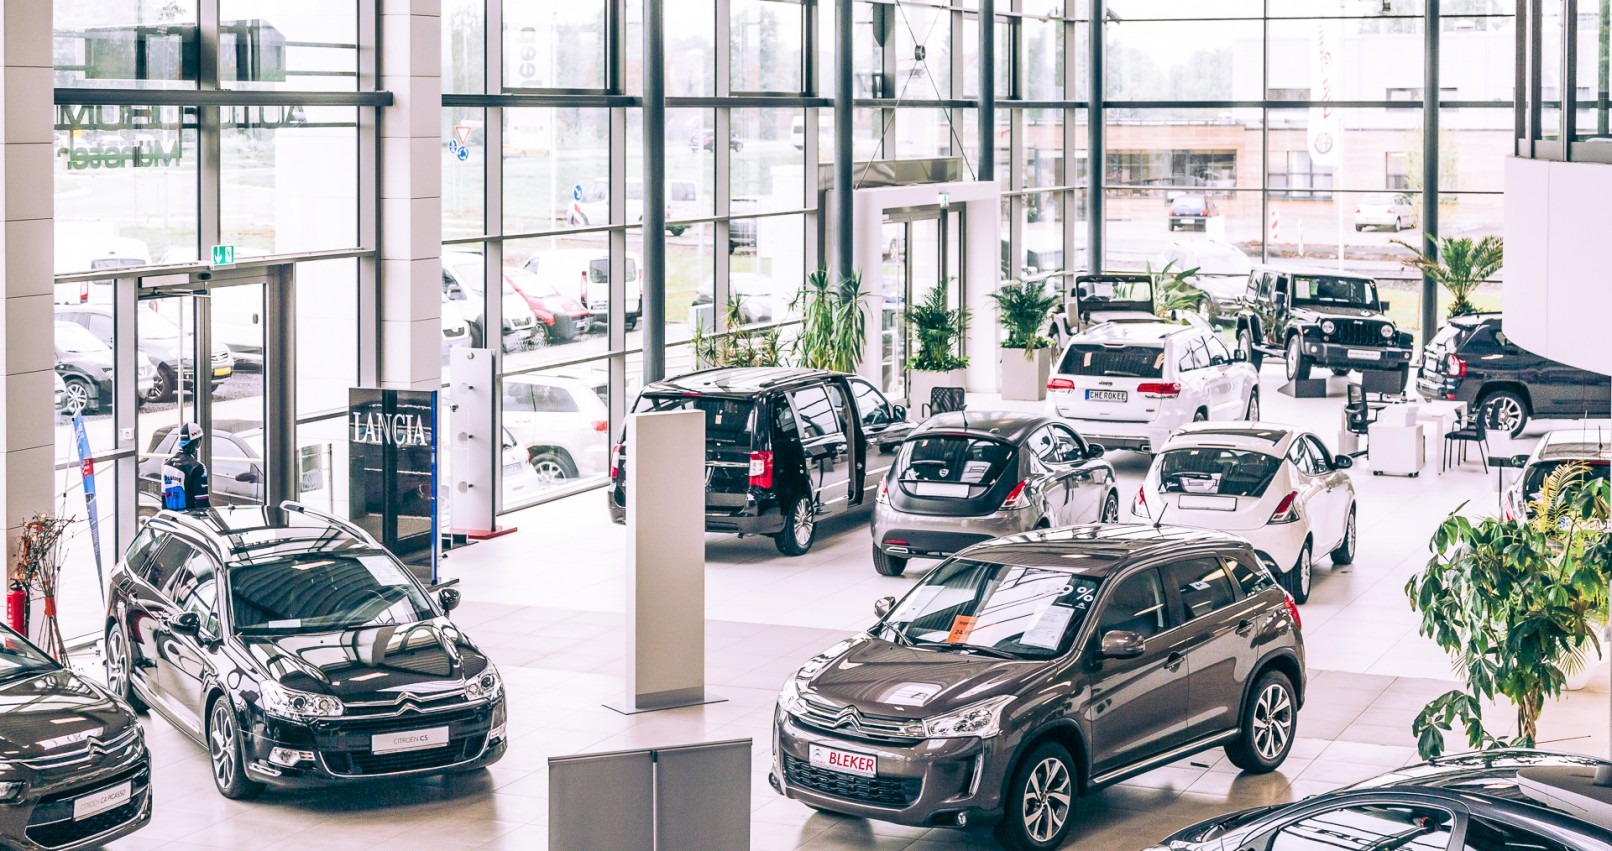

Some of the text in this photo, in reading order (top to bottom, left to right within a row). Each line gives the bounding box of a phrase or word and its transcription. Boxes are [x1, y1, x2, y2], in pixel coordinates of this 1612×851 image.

[1090, 391, 1126, 400] CHEROKEE
[352, 412, 428, 446] LANCIA
[829, 751, 875, 771] BLEKER
